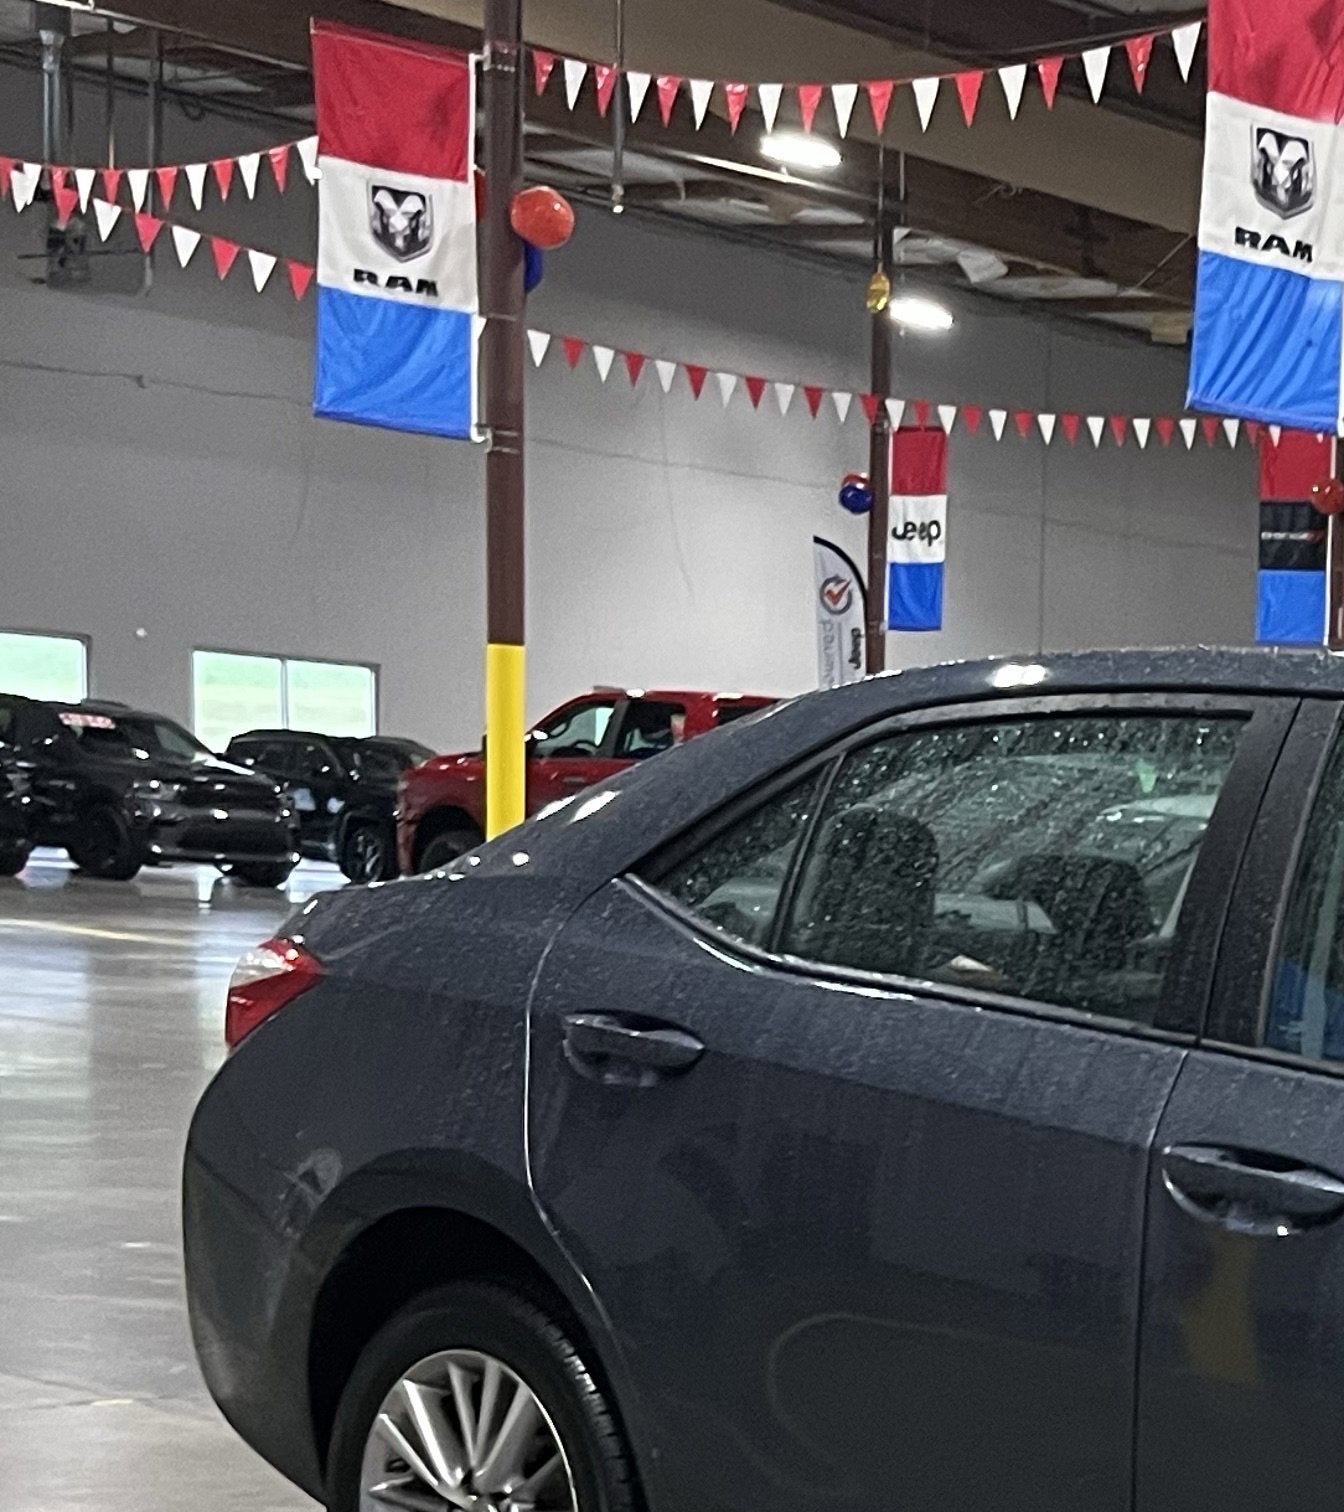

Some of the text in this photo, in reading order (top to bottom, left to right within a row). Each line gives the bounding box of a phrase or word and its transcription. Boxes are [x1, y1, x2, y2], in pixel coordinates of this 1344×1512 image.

[1234, 226, 1313, 263] RAM
[353, 268, 439, 297] RAM
[891, 520, 941, 547] Jeep
